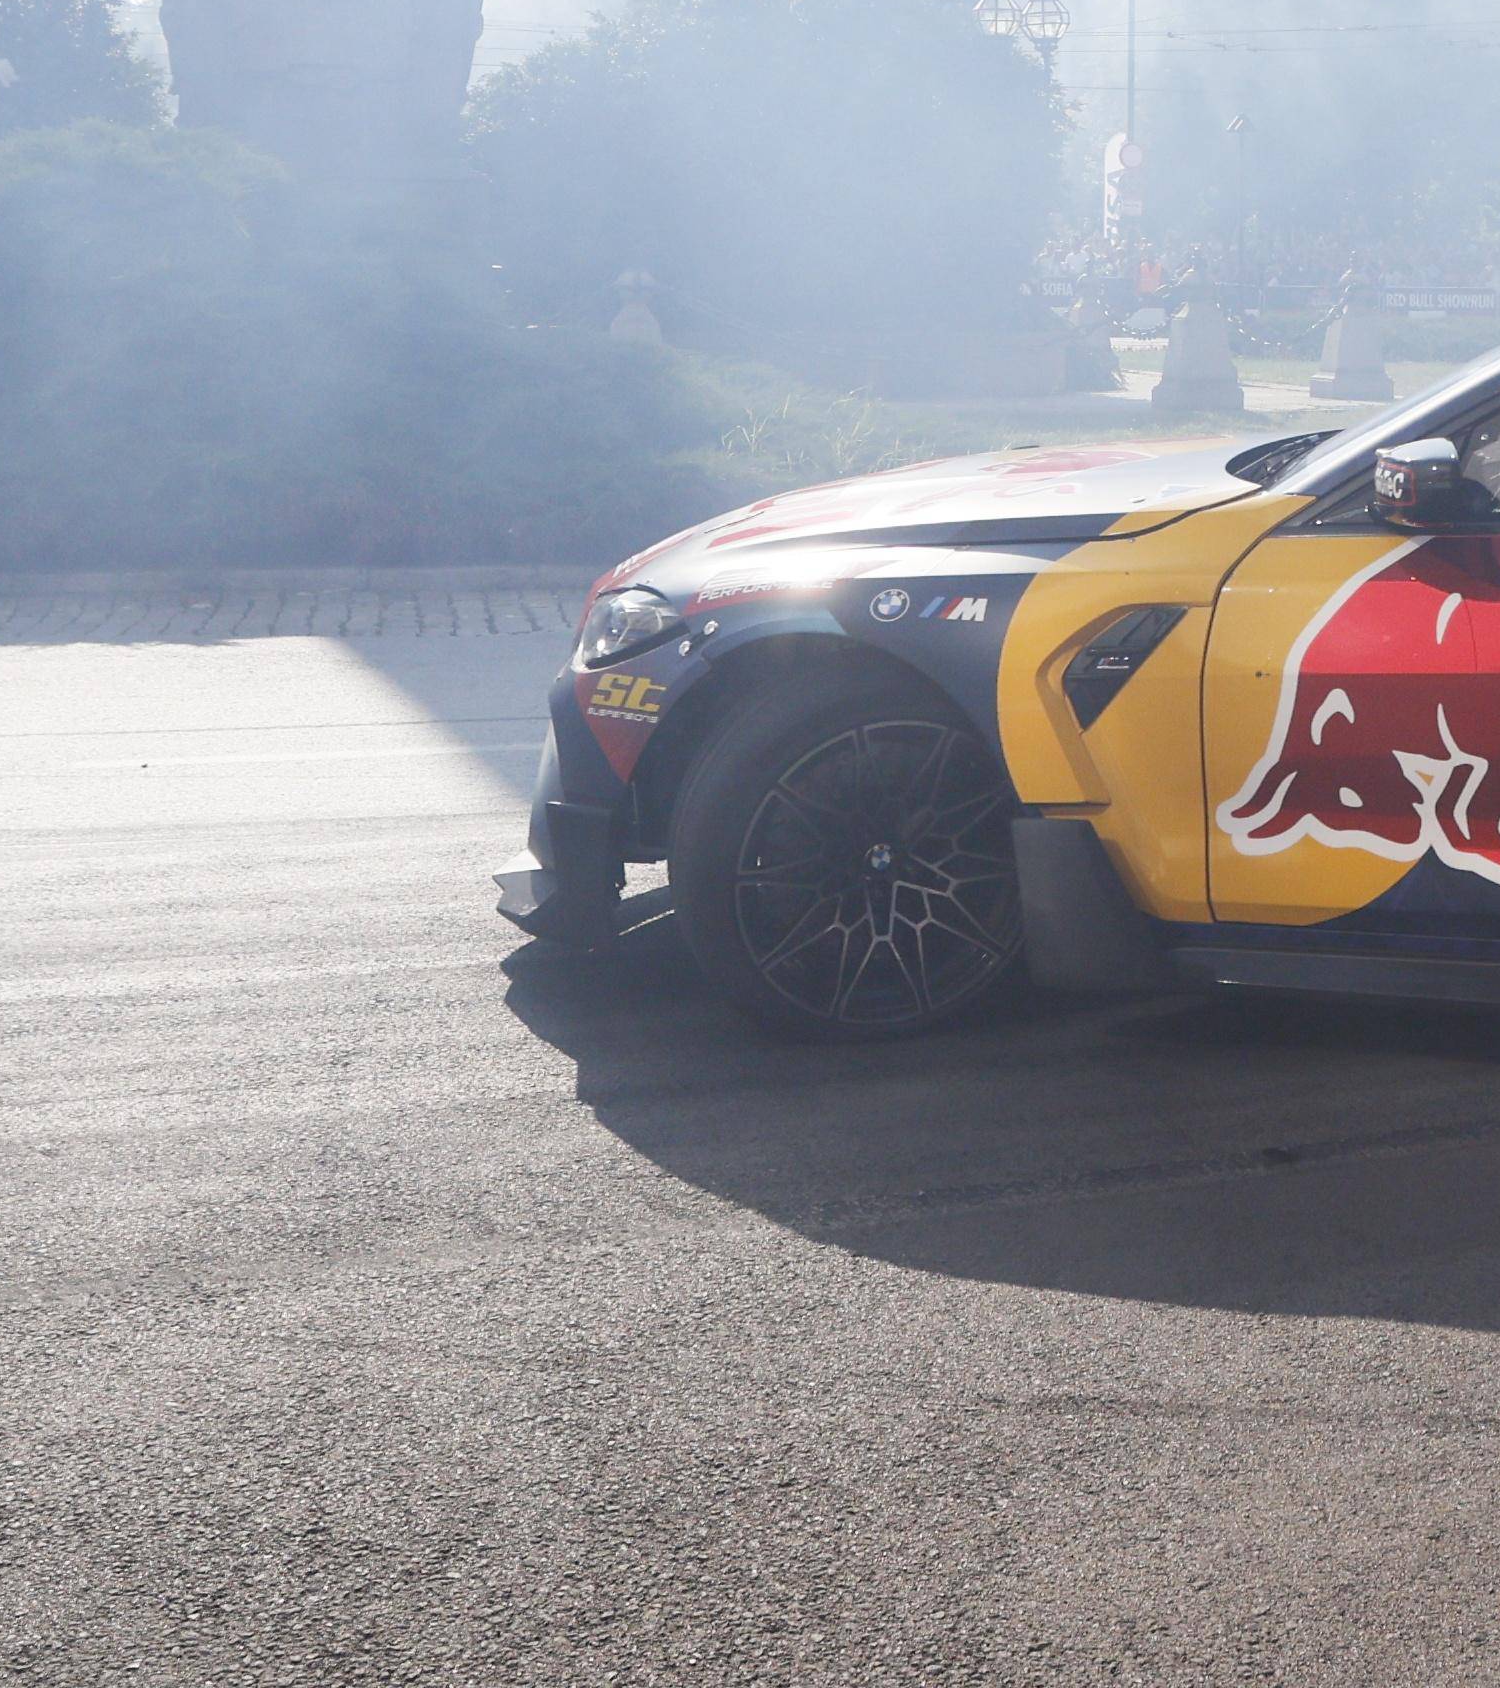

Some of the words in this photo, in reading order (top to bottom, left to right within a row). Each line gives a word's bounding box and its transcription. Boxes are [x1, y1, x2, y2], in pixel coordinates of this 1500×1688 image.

[1385, 293, 1406, 308] RED
[1408, 293, 1435, 309] BULL
[1437, 293, 1495, 309] SHOWRUN
